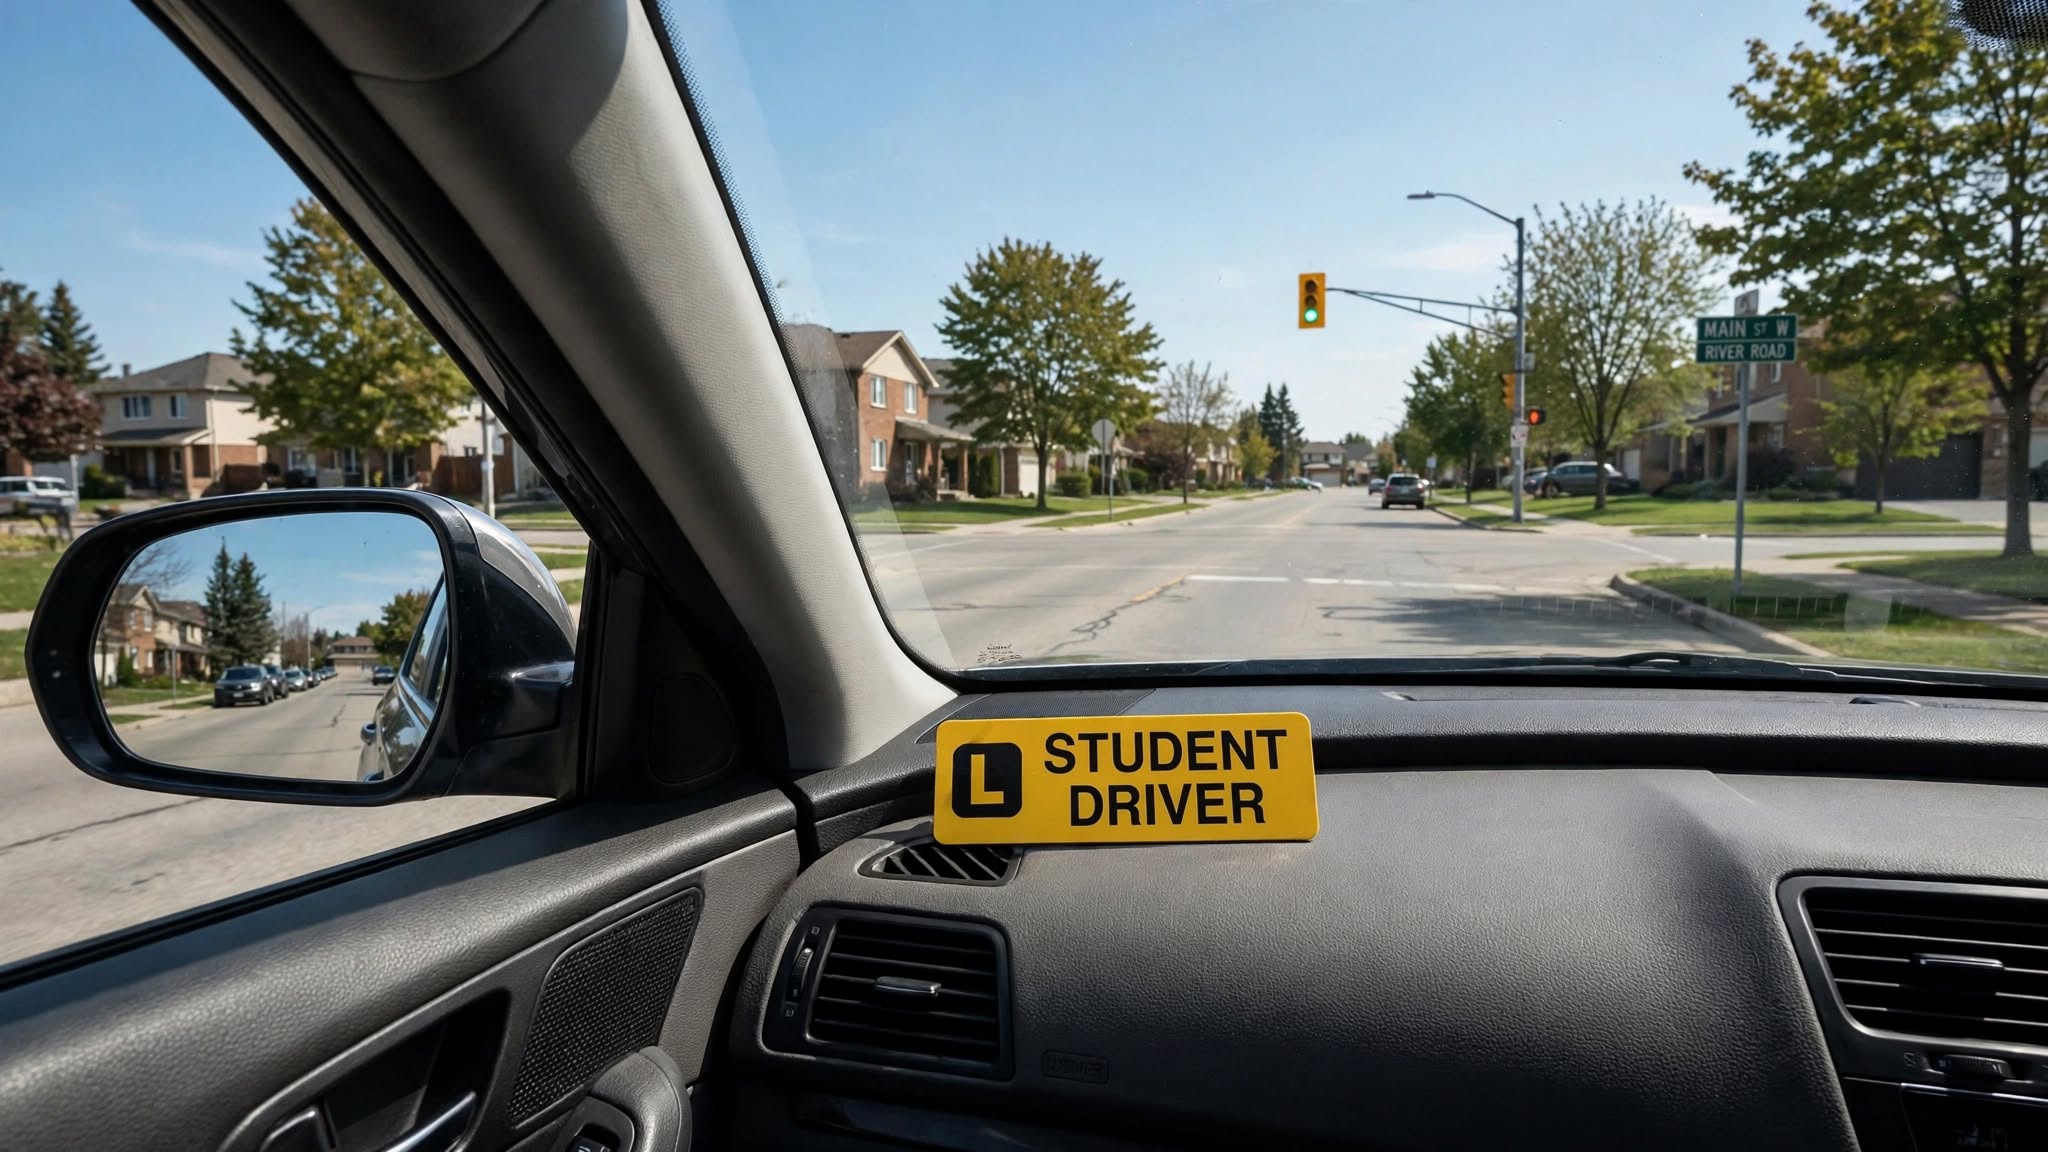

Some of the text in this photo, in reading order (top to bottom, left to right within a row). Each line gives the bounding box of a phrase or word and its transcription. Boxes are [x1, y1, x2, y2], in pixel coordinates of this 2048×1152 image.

[1704, 319, 1789, 337] MAIN ST W
[1705, 343, 1786, 359] RIVER ROAD
[1044, 729, 1287, 773] STUDENT
[970, 754, 1004, 805] L
[1070, 782, 1266, 826] DRIVER
